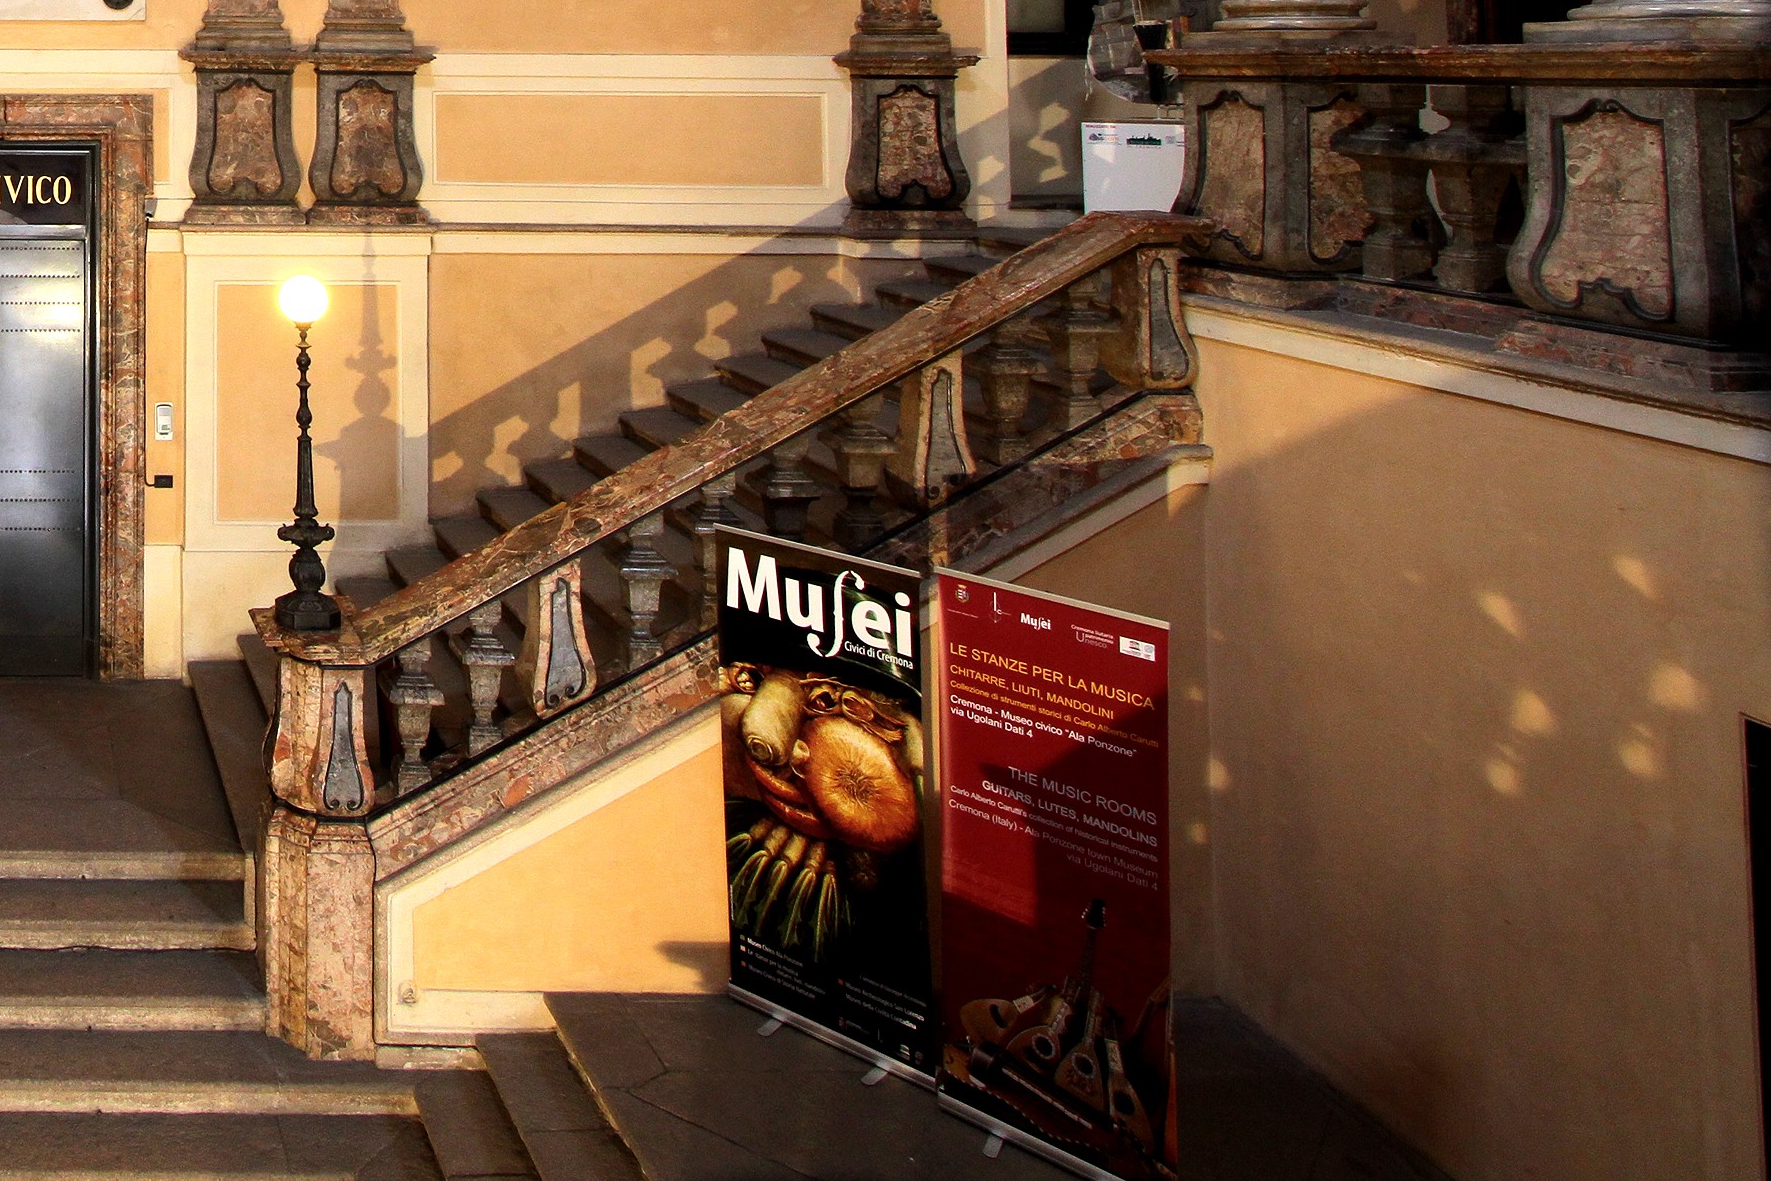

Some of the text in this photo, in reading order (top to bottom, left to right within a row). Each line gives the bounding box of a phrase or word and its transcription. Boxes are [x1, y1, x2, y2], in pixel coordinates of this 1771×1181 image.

[844, 640, 914, 670] Civici di Cremona
[949, 641, 1154, 711] LE STANZE PER LA MUSICA
[949, 664, 1113, 719] CHITARRE, LIUTI, MANDOLINI
[981, 779, 1157, 847] GUITARS, LUTES, MANDOLINS
[1007, 765, 1157, 825] THE MUSIC ROOMS
